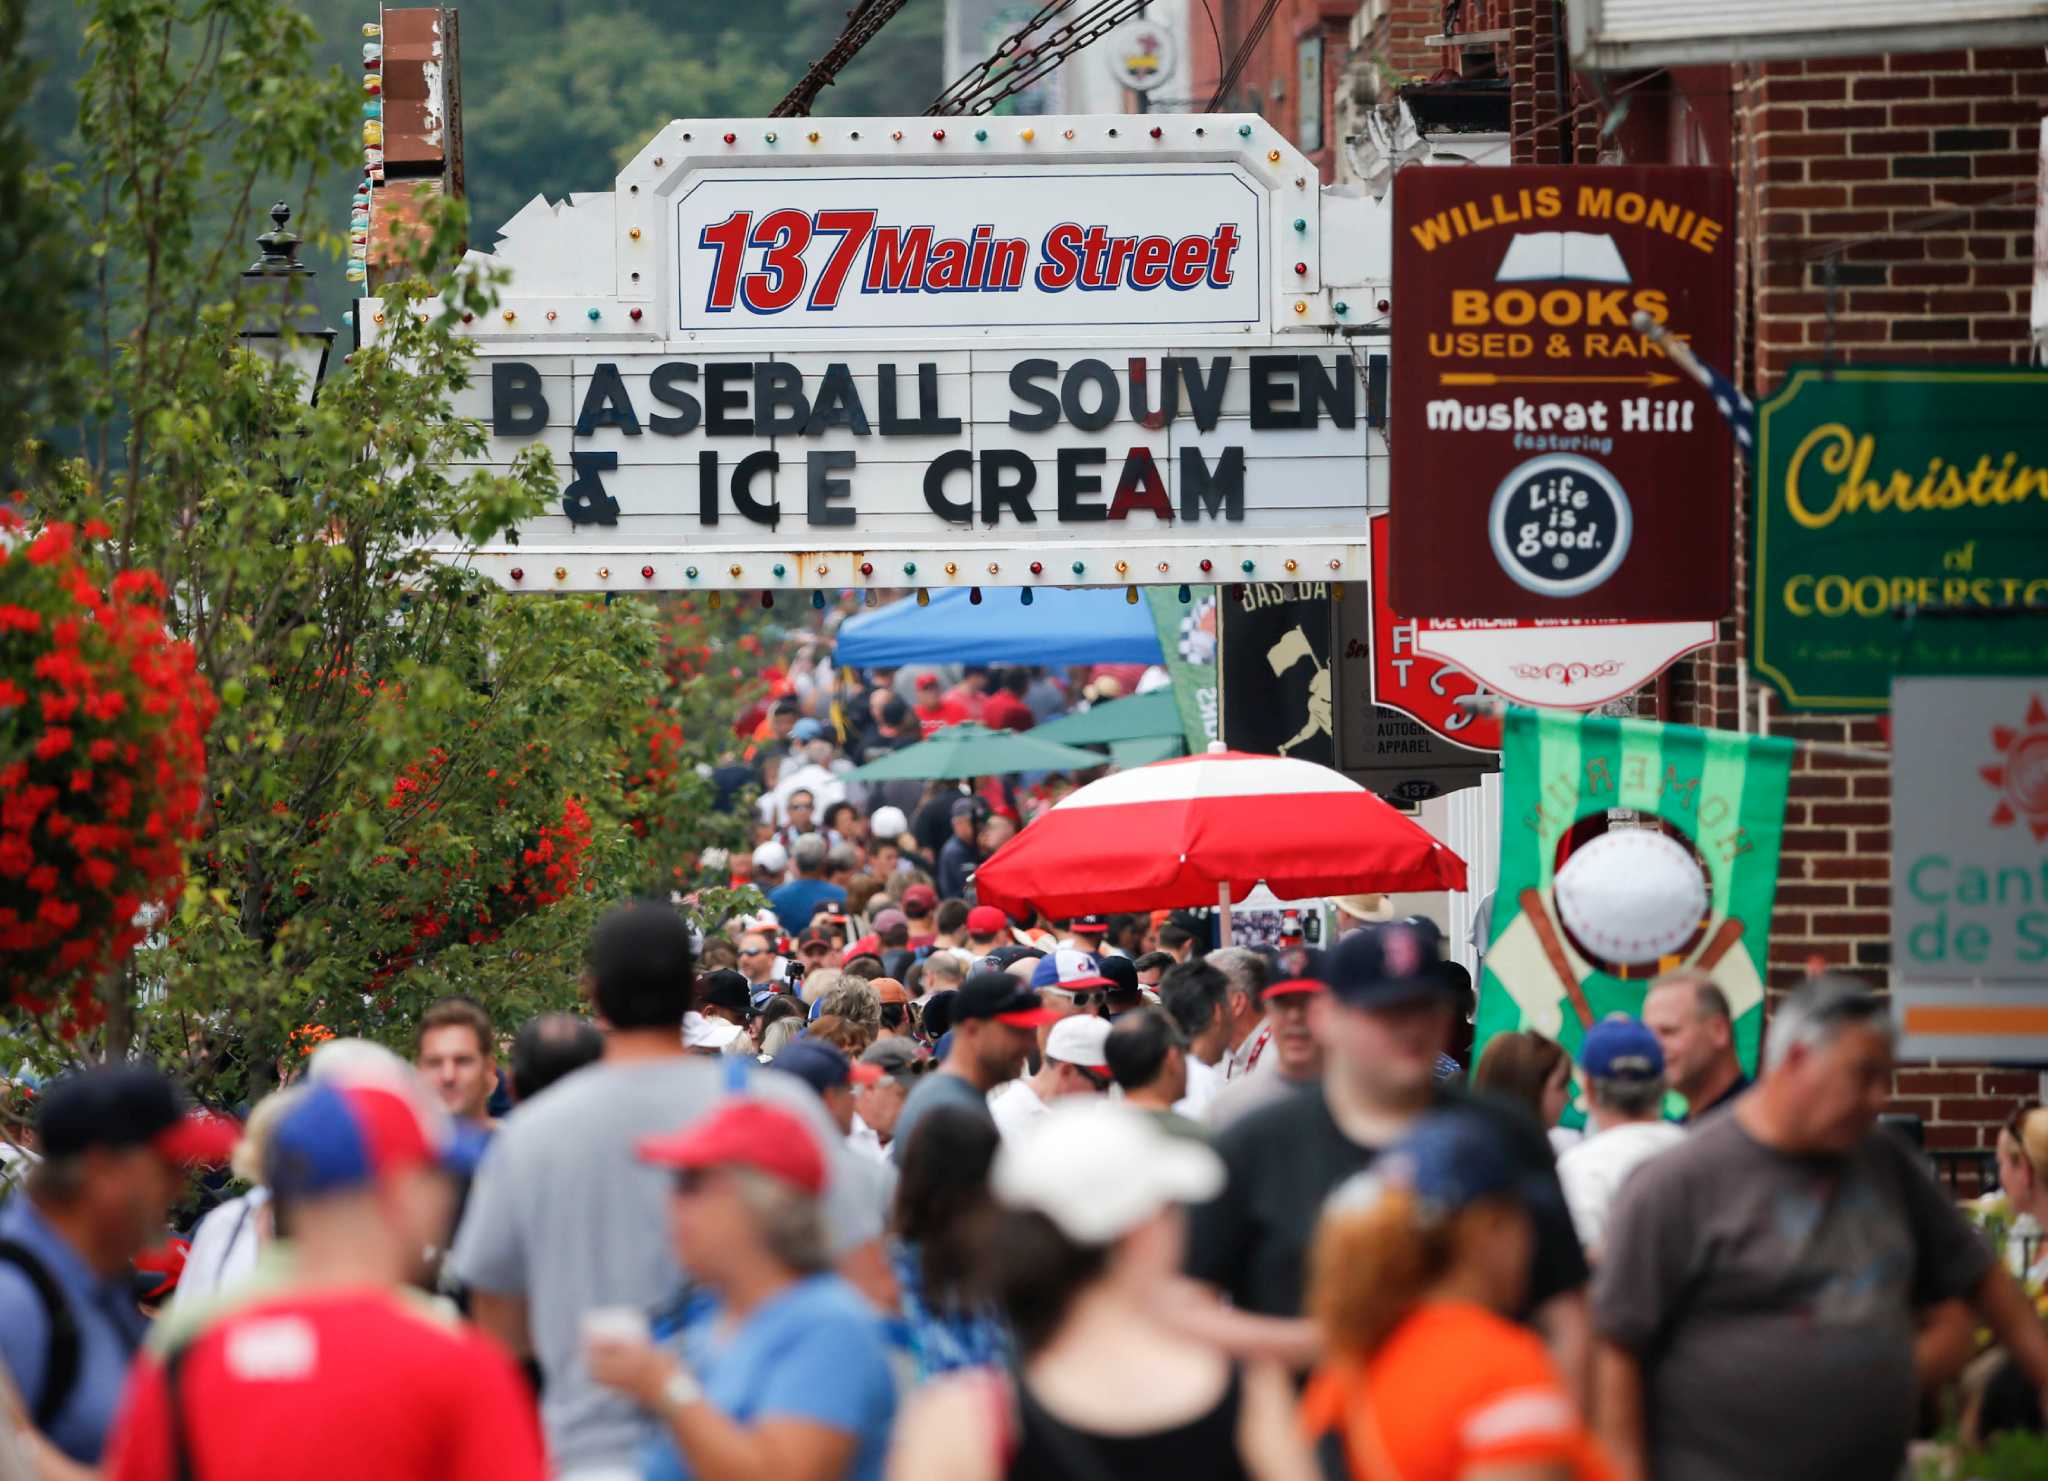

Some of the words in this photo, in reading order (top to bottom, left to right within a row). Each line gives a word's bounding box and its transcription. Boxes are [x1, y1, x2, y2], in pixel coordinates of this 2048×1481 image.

[1411, 186, 1562, 252] WILLIS
[1577, 187, 1724, 254] MONIE
[699, 208, 878, 315] 137
[861, 224, 1030, 294] Main
[1034, 221, 1241, 293] Street
[1451, 289, 1669, 327] BOOKS
[1428, 333, 1536, 359] USED
[1545, 333, 1571, 359] &
[1585, 333, 1692, 359] RAR
[492, 361, 962, 437] BASEBALL
[1426, 398, 1608, 432] Muskrat
[1621, 399, 1695, 433] Hill
[1513, 434, 1614, 456] featuring
[562, 450, 621, 527] &
[698, 449, 857, 526] ICE
[922, 446, 1245, 525] CREAM
[1529, 476, 1589, 510] Life
[1785, 422, 2048, 529] Christin
[1549, 507, 1577, 528] is
[1517, 523, 1602, 558] good.
[1377, 739, 1432, 754] APPAREL
[1403, 784, 1430, 798] 137
[1907, 906, 1992, 964] de
